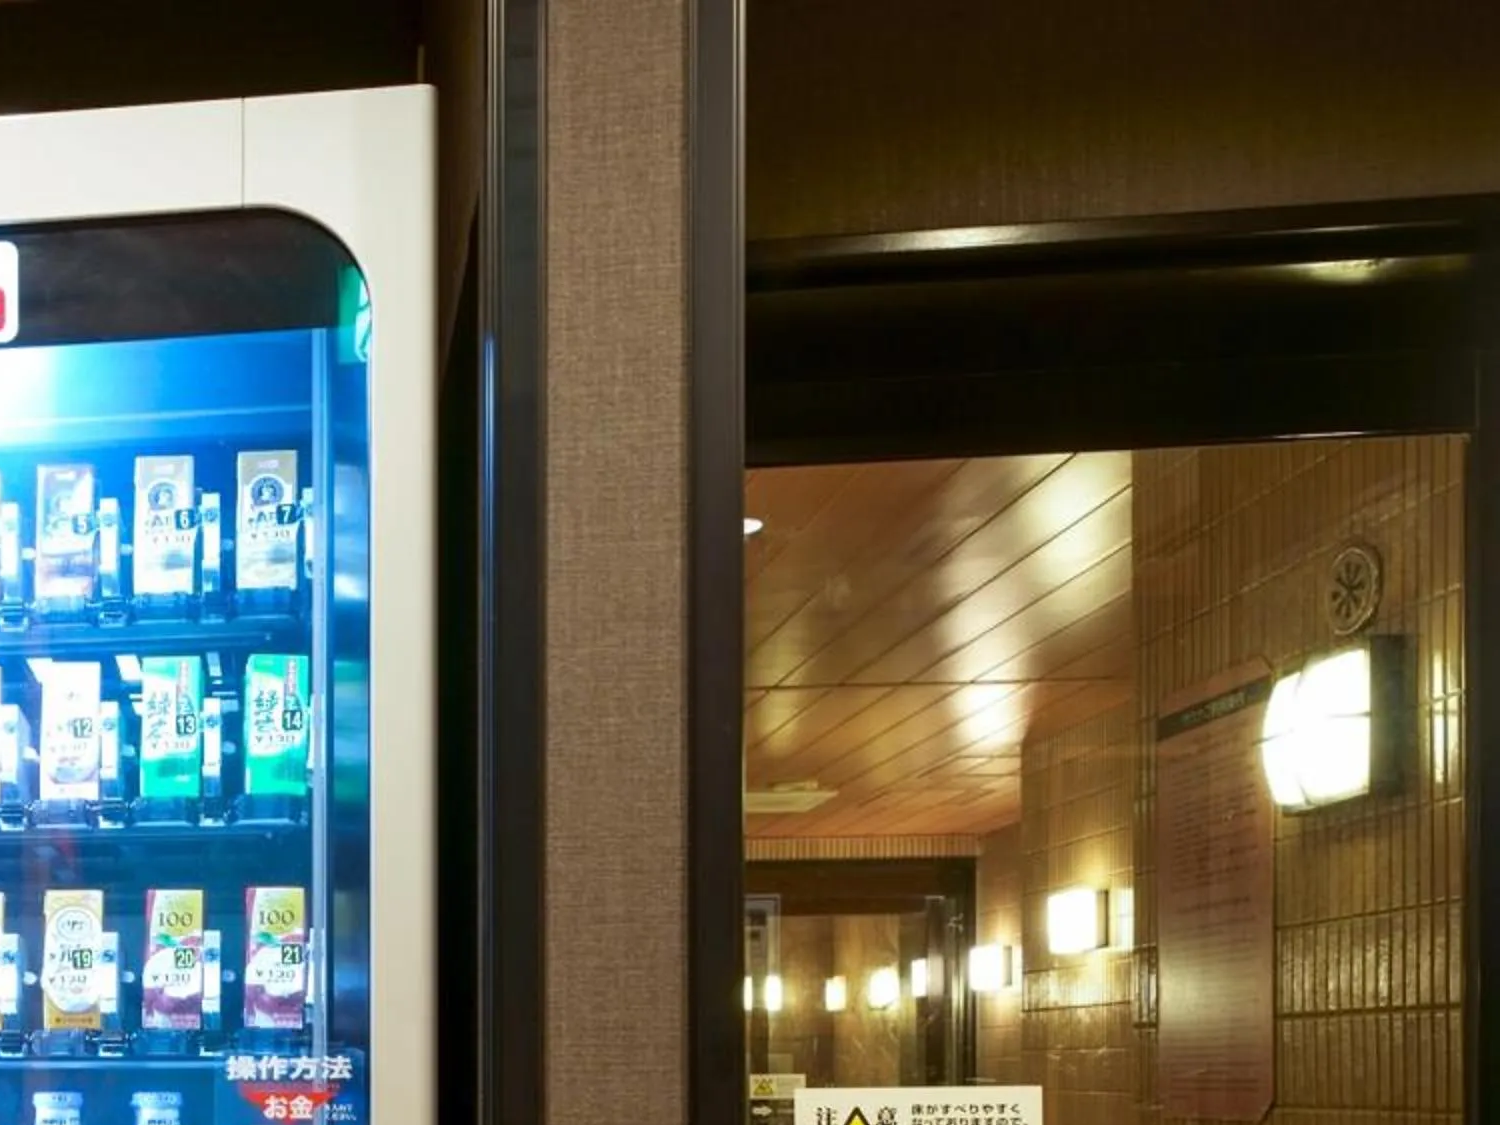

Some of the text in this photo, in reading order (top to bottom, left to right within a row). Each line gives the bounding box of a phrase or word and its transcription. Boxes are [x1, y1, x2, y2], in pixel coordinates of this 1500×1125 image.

[158, 912, 194, 928] 100
[260, 910, 296, 926] 100
[226, 1055, 352, 1081] 操作方法
[263, 1095, 314, 1120] お金
